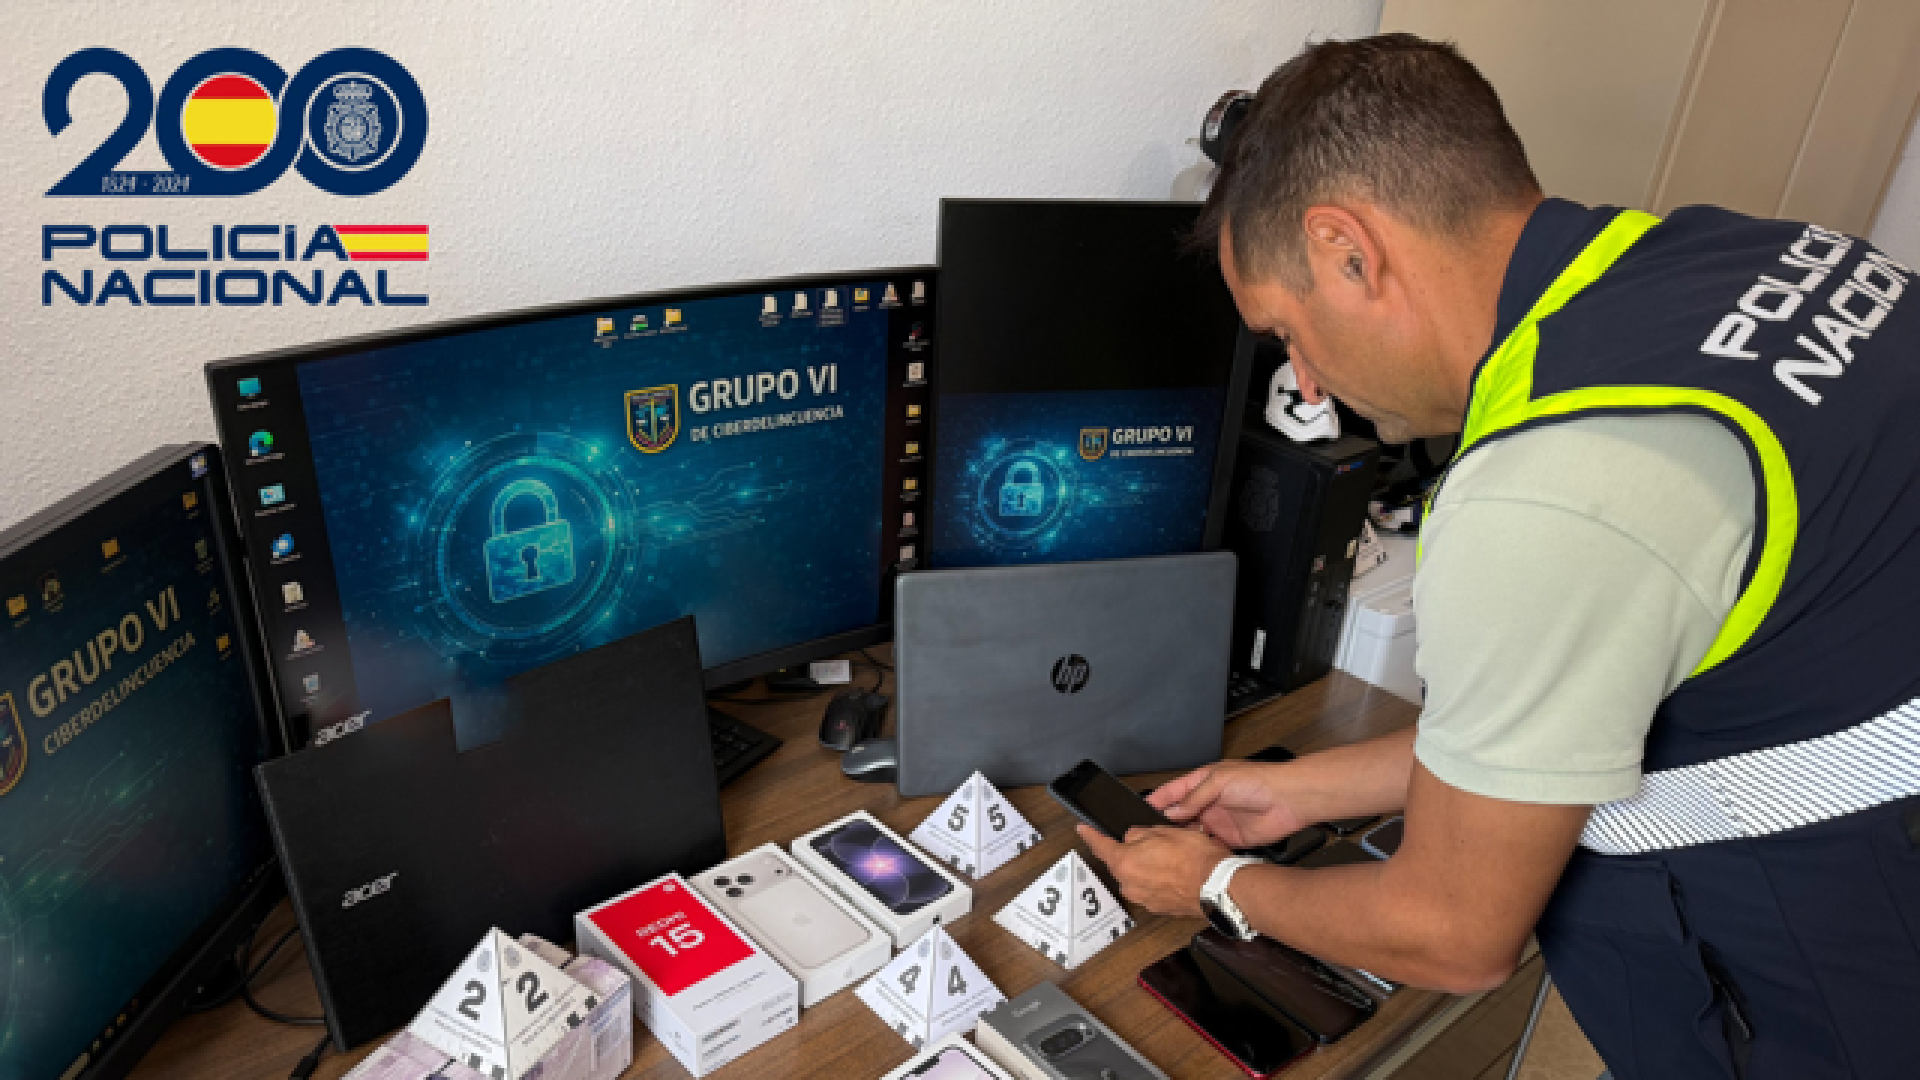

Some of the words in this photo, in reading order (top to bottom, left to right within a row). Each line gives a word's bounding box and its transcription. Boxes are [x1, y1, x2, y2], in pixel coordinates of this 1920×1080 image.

[689, 368, 799, 414] GRUPO
[806, 363, 838, 394] VI
[1112, 425, 1171, 445] GRUPO
[1175, 425, 1195, 442] VI
[27, 612, 145, 718] GRUPO
[145, 585, 181, 631] VI
[42, 631, 197, 756] CIBERDELINCUENCIA
[315, 709, 372, 747] acer
[986, 804, 1008, 832] 5
[342, 870, 399, 909] acer
[1038, 887, 1062, 917] 3
[1080, 888, 1101, 918] 3
[647, 923, 706, 958] 15
[516, 971, 549, 1012] 2
[899, 964, 922, 994] 4
[947, 965, 967, 996] 4
[456, 980, 488, 1021] 2
